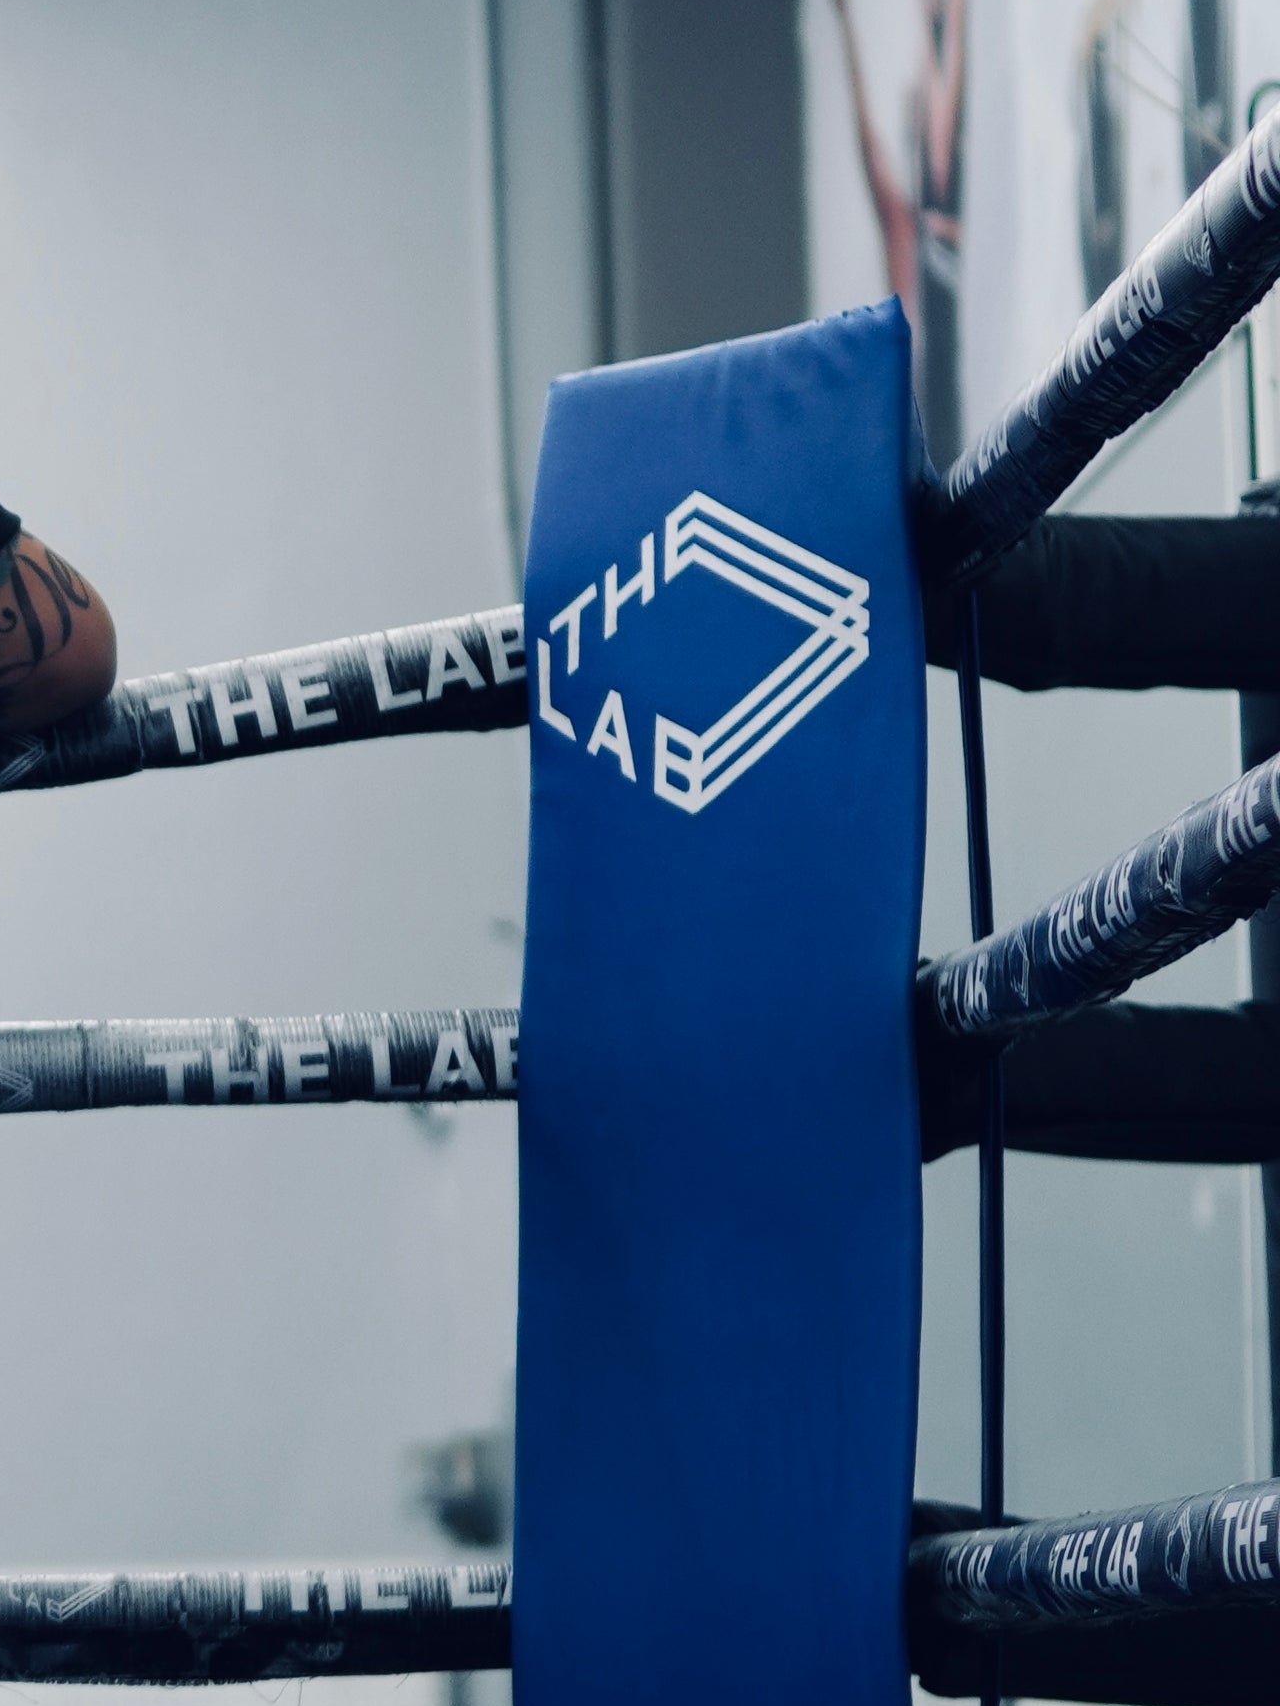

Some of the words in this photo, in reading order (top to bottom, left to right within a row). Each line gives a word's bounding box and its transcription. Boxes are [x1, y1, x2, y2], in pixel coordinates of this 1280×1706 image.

[148, 660, 338, 755] THE
[365, 618, 525, 712] LAB
[1048, 876, 1095, 971] THE
[1091, 848, 1137, 941] LAB
[145, 1041, 330, 1104] THE
[372, 1025, 519, 1094] LAB
[1052, 1529, 1098, 1591] THE
[1095, 1521, 1144, 1595] LAB
[1222, 1495, 1276, 1583] THE
